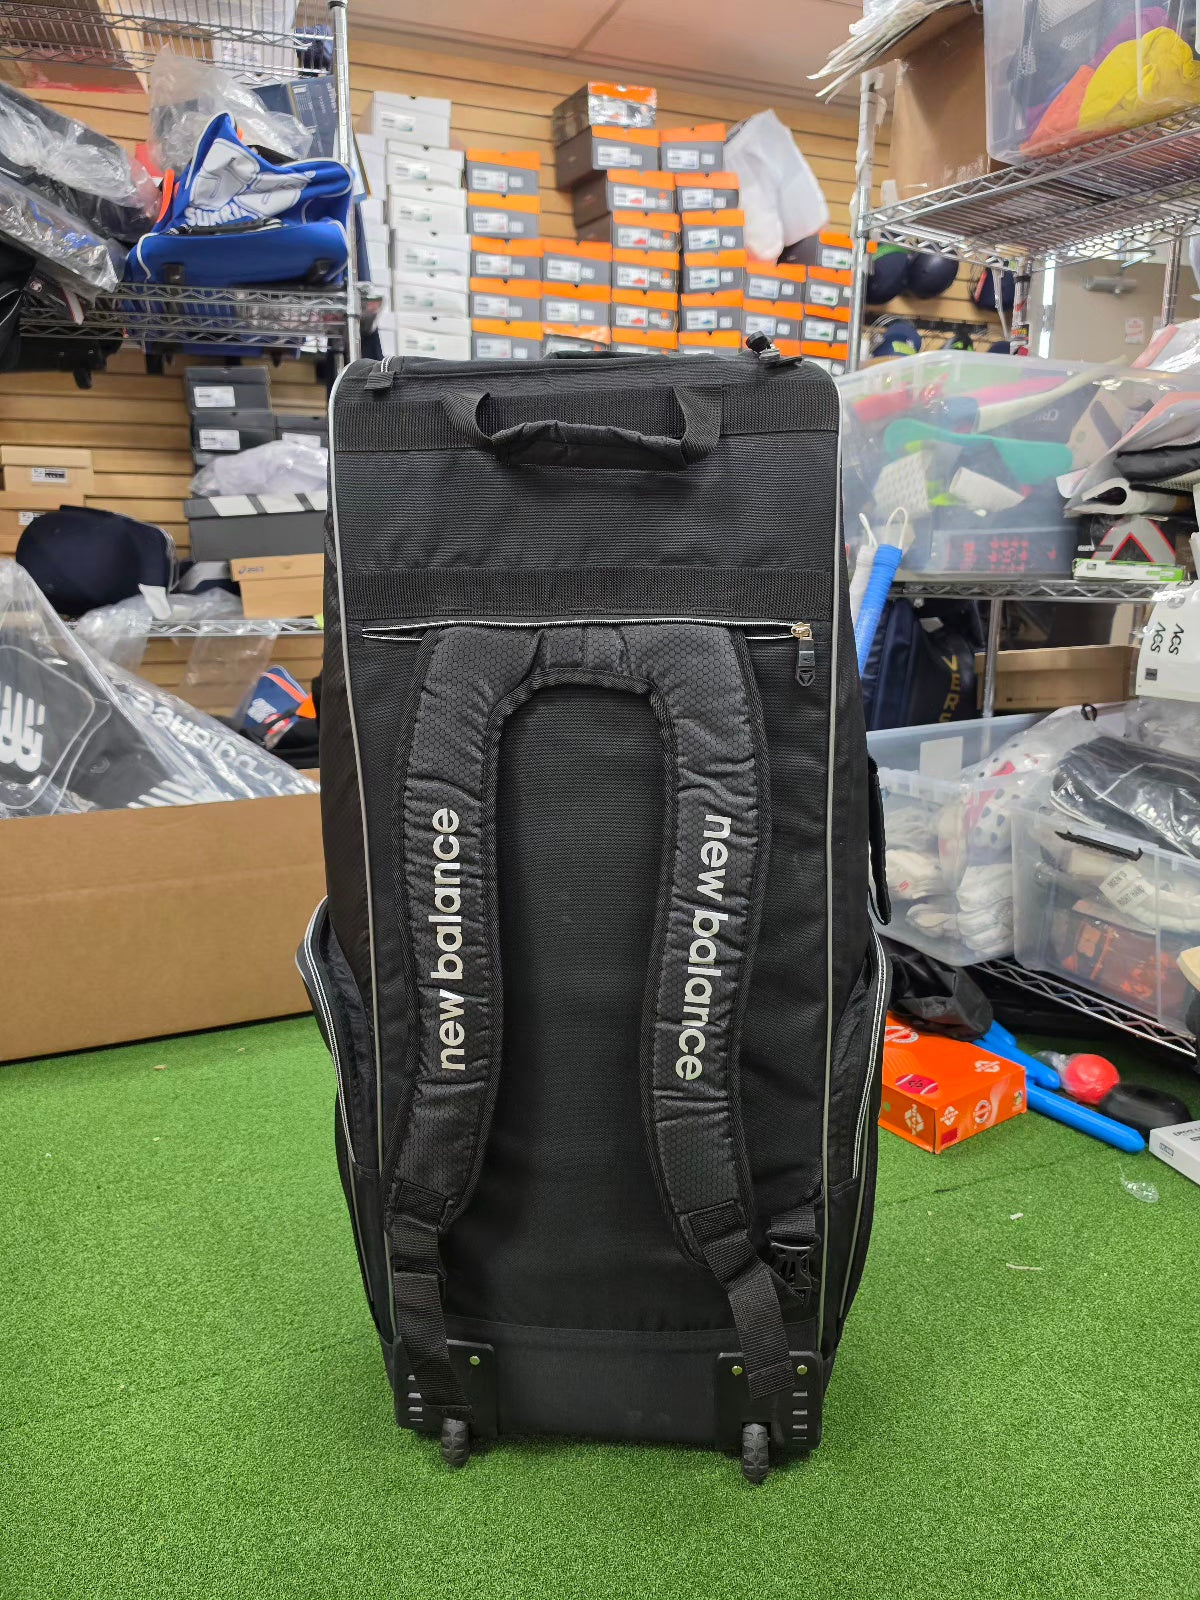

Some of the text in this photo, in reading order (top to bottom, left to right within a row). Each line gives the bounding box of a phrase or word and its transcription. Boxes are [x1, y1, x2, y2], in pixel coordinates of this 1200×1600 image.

[428, 808, 466, 1070] new balance
[675, 814, 732, 1081] new balance
